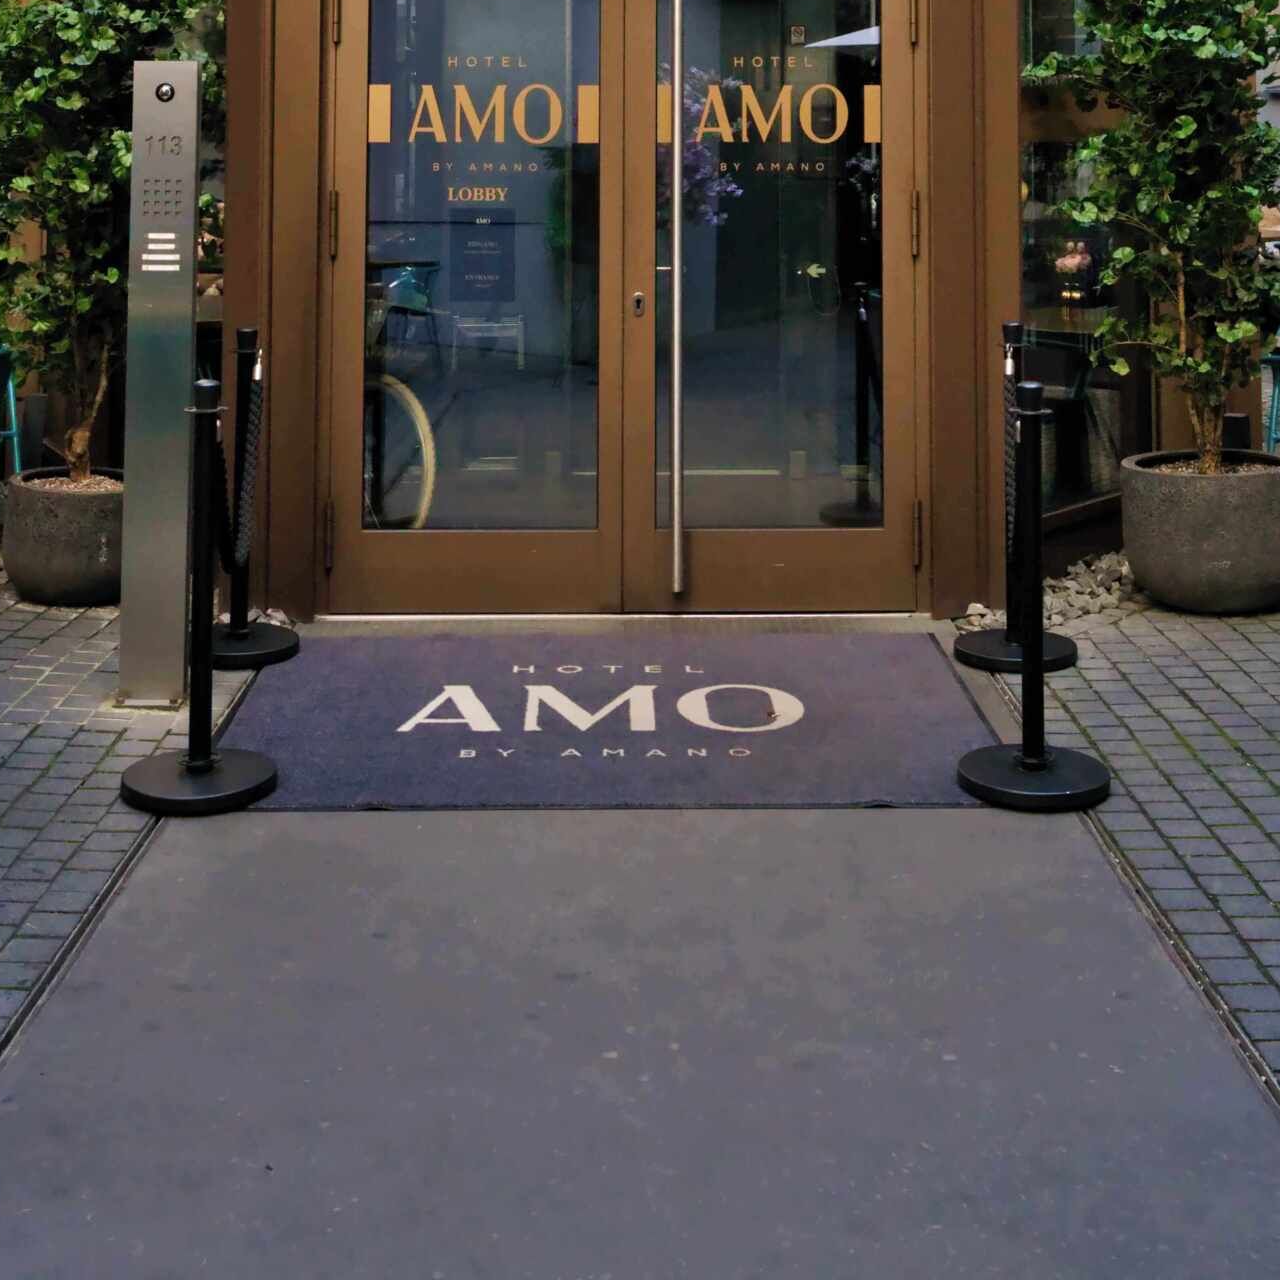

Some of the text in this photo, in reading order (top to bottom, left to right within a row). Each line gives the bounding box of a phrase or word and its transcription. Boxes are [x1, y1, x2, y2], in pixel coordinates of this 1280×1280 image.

[447, 56, 528, 68] HOTEL
[733, 56, 813, 68] HOTEL
[408, 83, 563, 145] AMO
[695, 83, 849, 144] AMO
[144, 135, 184, 157] 113
[432, 162, 538, 172] BY AMANO
[720, 162, 825, 172] BY AMANO
[447, 187, 509, 202] LOBBY
[512, 665, 705, 674] HOTEL
[395, 684, 805, 733] AMO
[458, 748, 753, 758] BY AMANO
